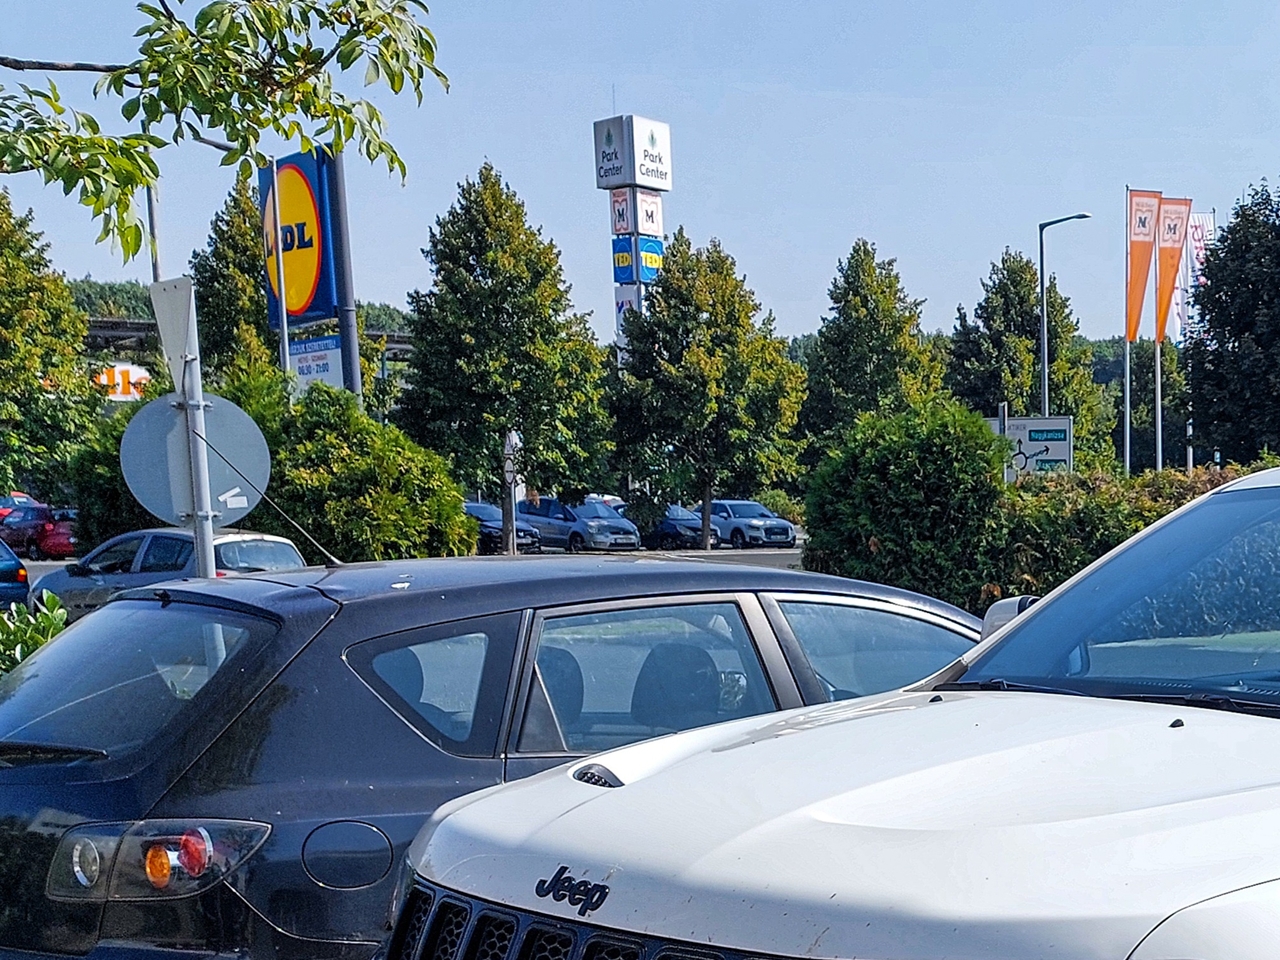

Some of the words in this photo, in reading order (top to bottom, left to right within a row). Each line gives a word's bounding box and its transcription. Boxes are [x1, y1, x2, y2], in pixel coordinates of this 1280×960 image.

[601, 149, 619, 163] Park
[643, 149, 664, 165] Park
[598, 164, 624, 178] Center
[639, 163, 669, 181] Center
[617, 207, 626, 223] M
[645, 210, 655, 224] M
[1166, 223, 1178, 235] M
[265, 221, 314, 259] LDL
[535, 865, 611, 918] Jeep
